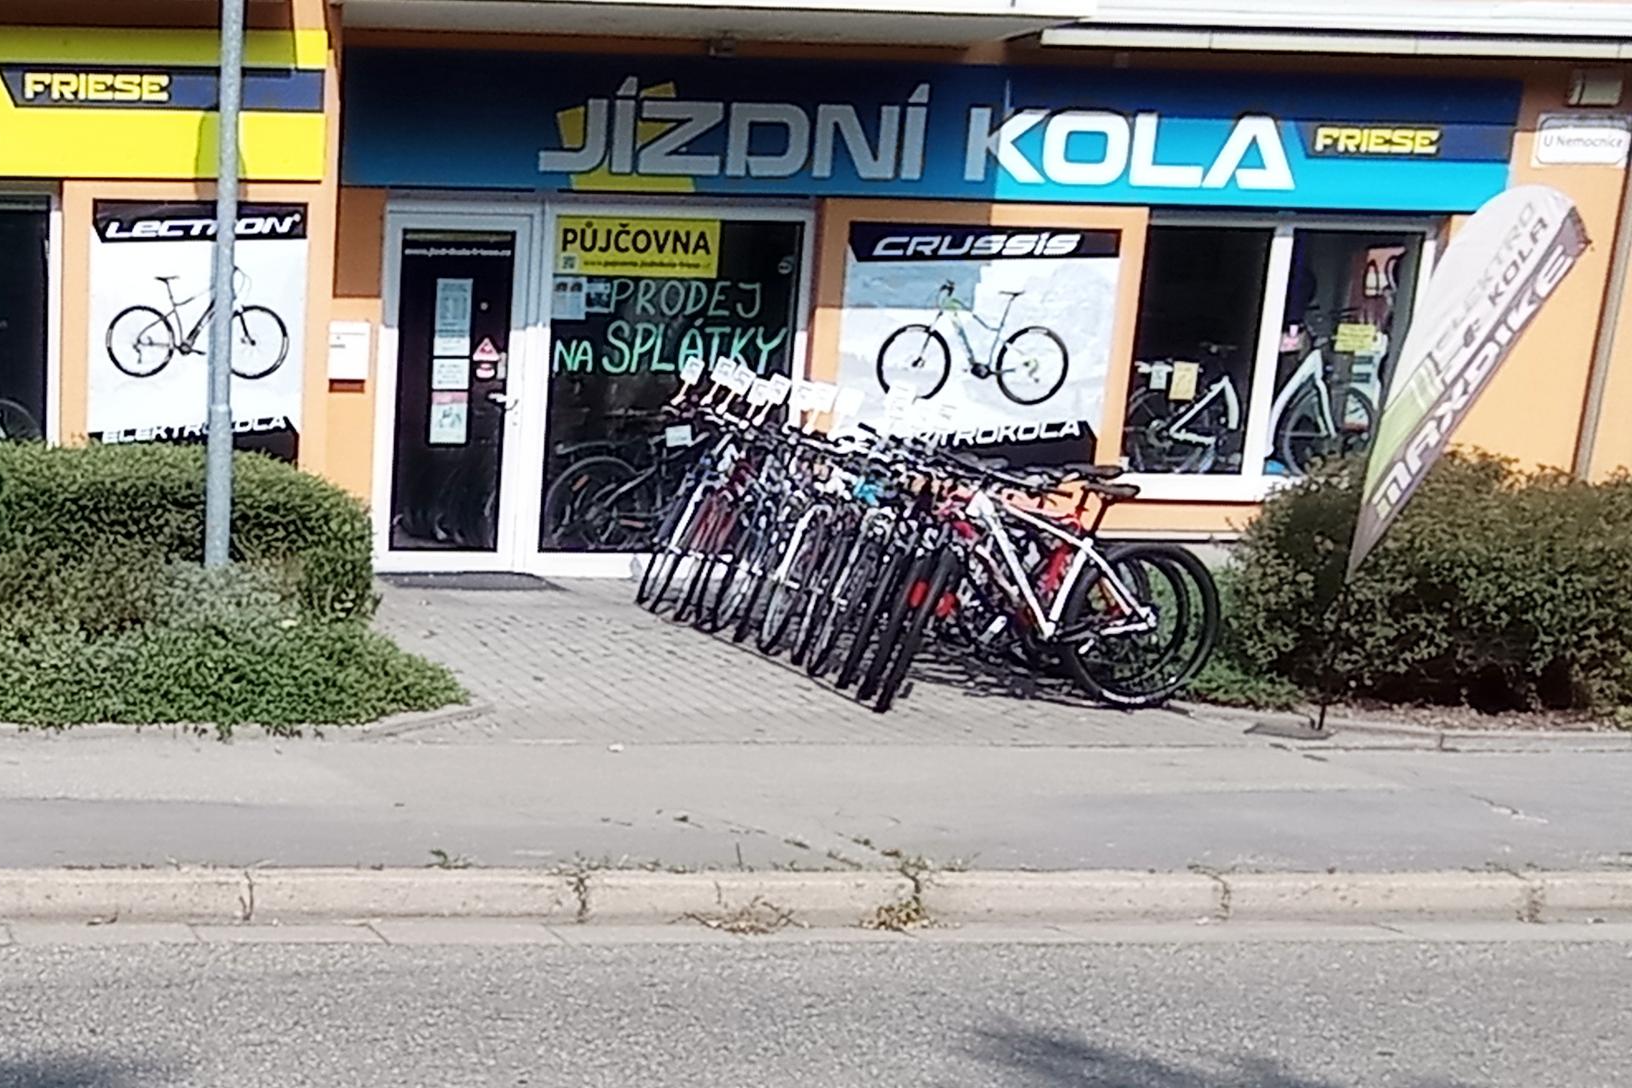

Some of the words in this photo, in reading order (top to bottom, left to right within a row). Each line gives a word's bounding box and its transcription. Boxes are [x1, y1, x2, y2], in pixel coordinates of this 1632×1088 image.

[23, 72, 171, 102] FRIESE
[537, 75, 931, 182] JÍZDNÍ
[963, 108, 1298, 192] KOLA
[1314, 126, 1442, 155] FRIESE
[561, 220, 712, 255] PŮJČOVNA
[1487, 217, 1549, 307] KOLA
[609, 278, 762, 318] PRODEJ
[552, 339, 594, 372] NA
[601, 316, 789, 374] SPLÁTKY
